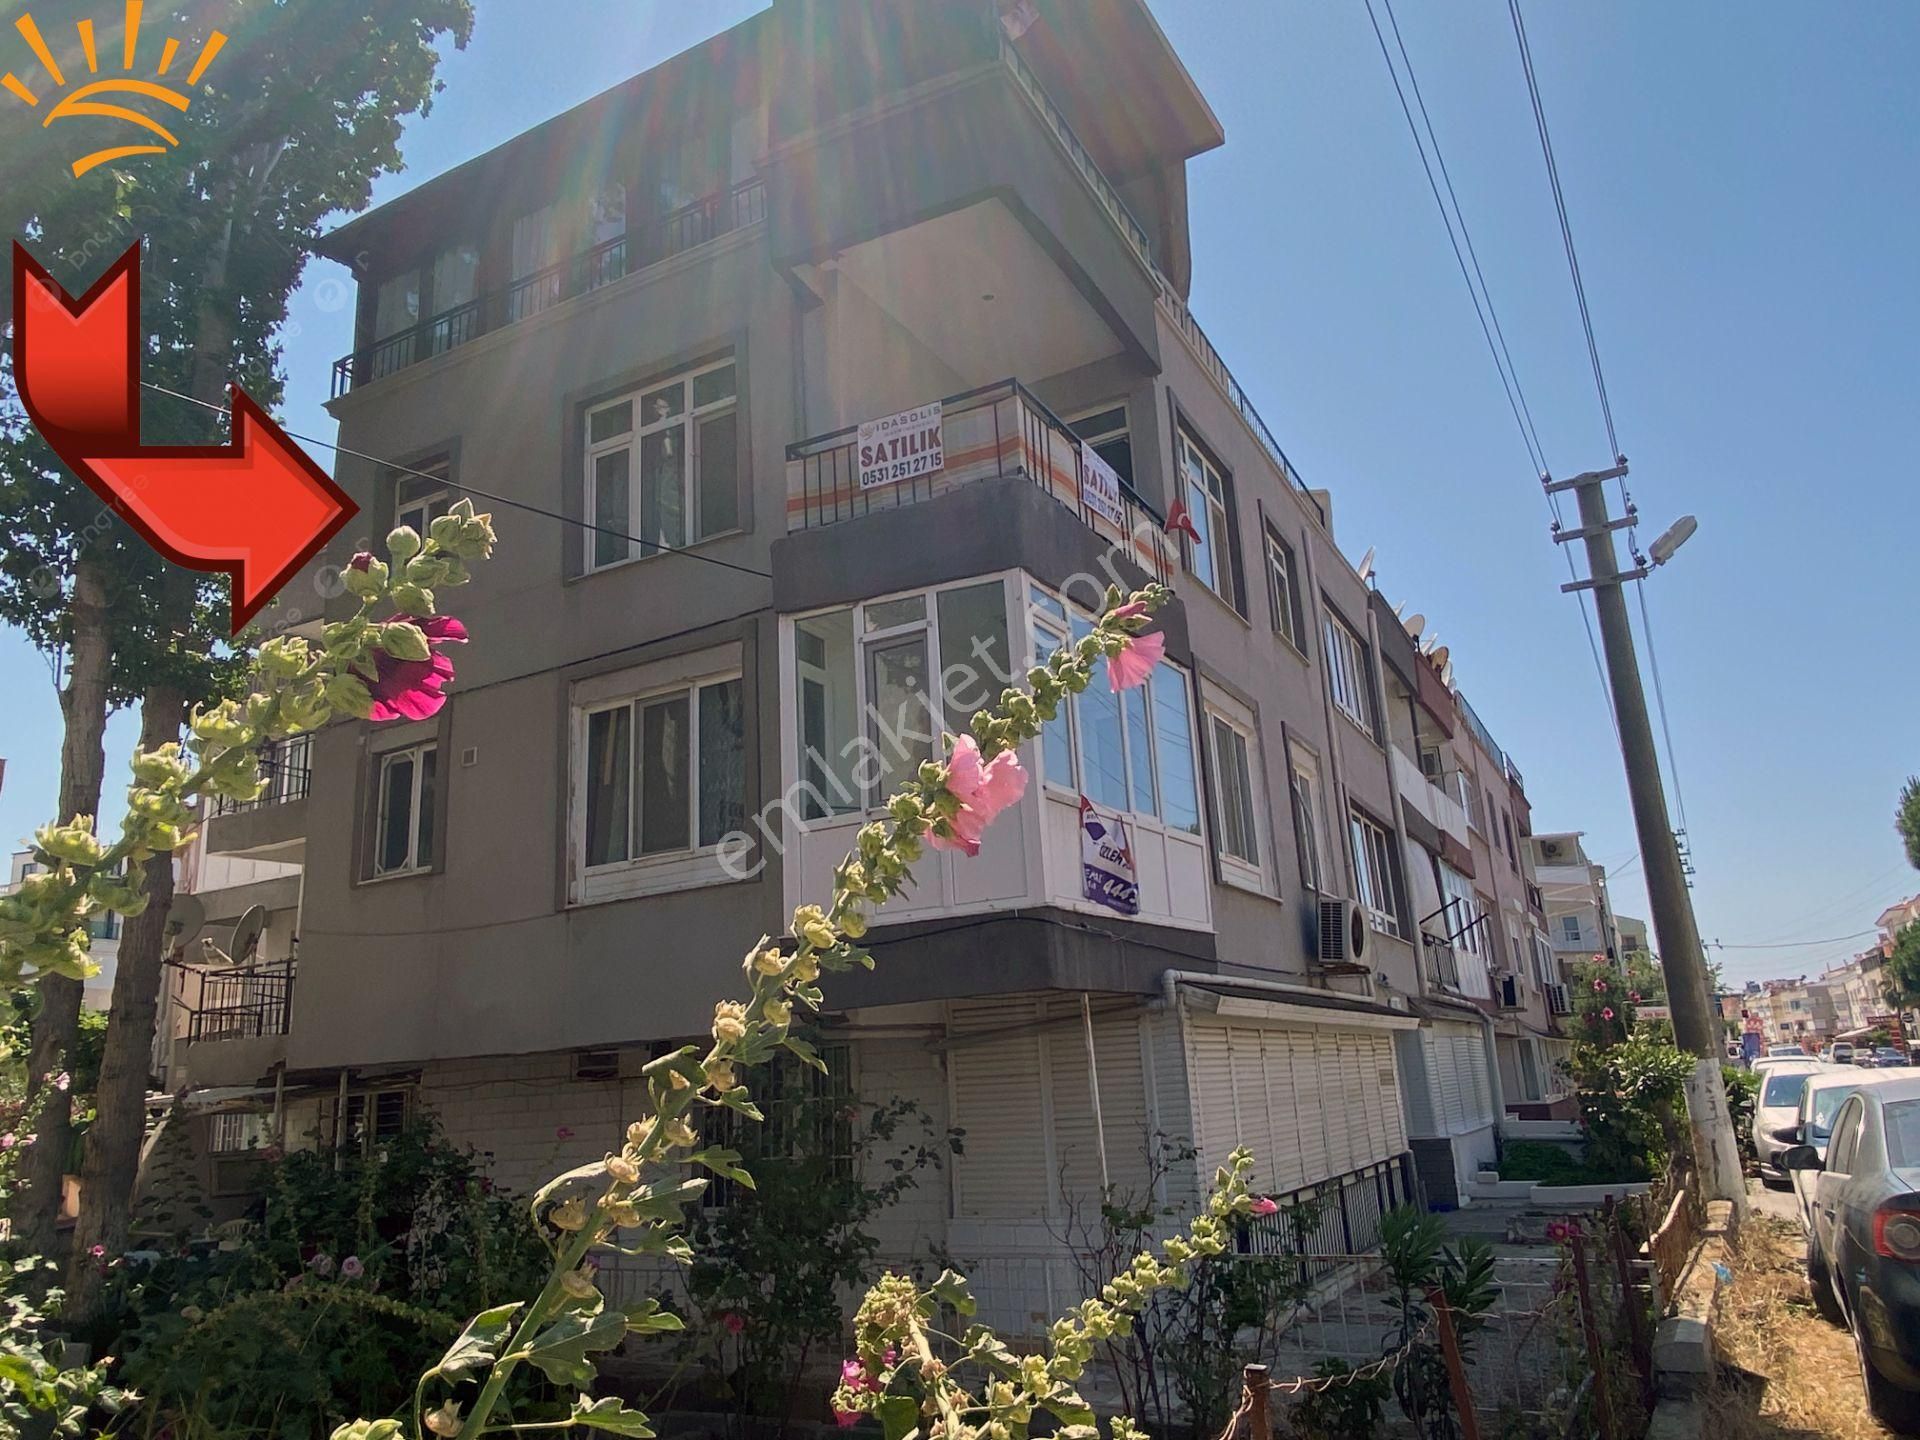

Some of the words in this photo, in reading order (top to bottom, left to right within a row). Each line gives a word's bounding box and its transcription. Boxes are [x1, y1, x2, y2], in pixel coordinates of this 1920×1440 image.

[860, 426, 942, 467] SATILIK
[862, 467, 889, 485] 0531
[891, 460, 911, 479] 251
[913, 455, 927, 472] 27
[930, 452, 942, 467] 15
